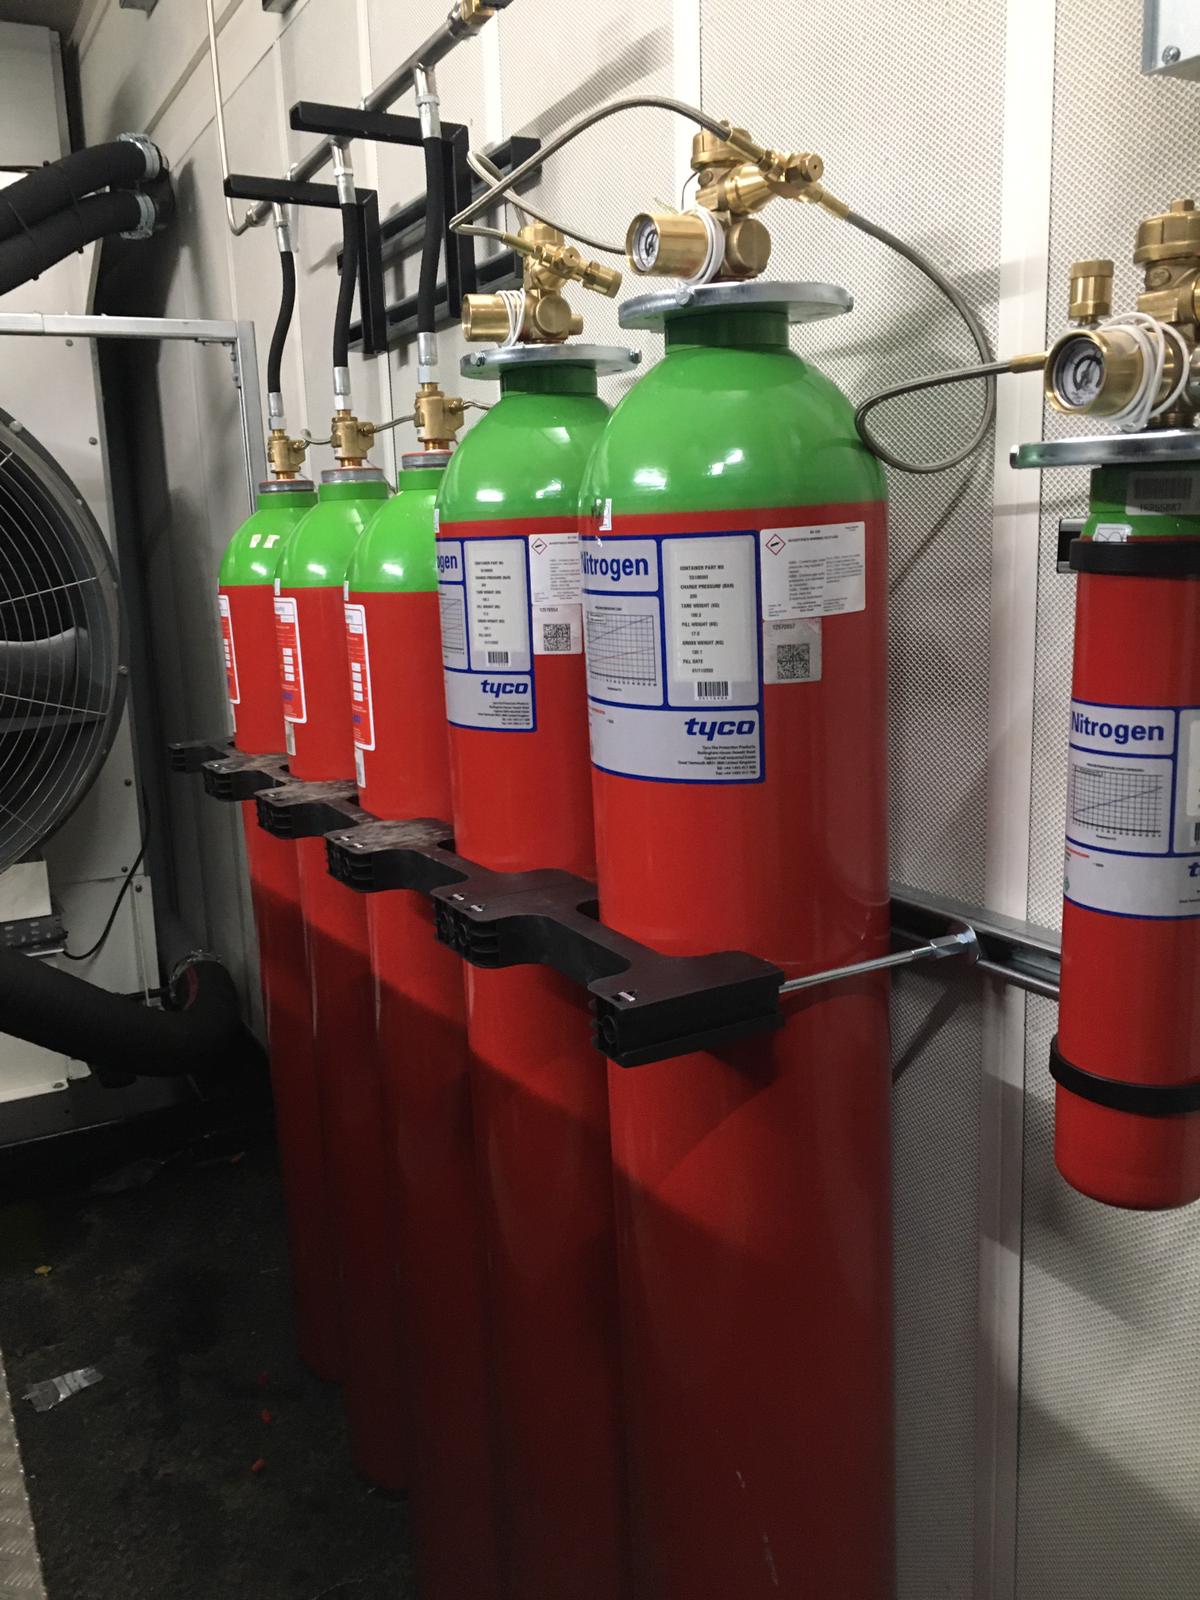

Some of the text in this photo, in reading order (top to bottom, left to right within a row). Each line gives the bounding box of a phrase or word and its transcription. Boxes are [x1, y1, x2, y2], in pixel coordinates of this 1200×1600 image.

[580, 552, 649, 581] Nitrogen
[480, 679, 528, 698] tyco
[684, 717, 756, 742] tyco
[1071, 710, 1164, 745] Nitrogen
